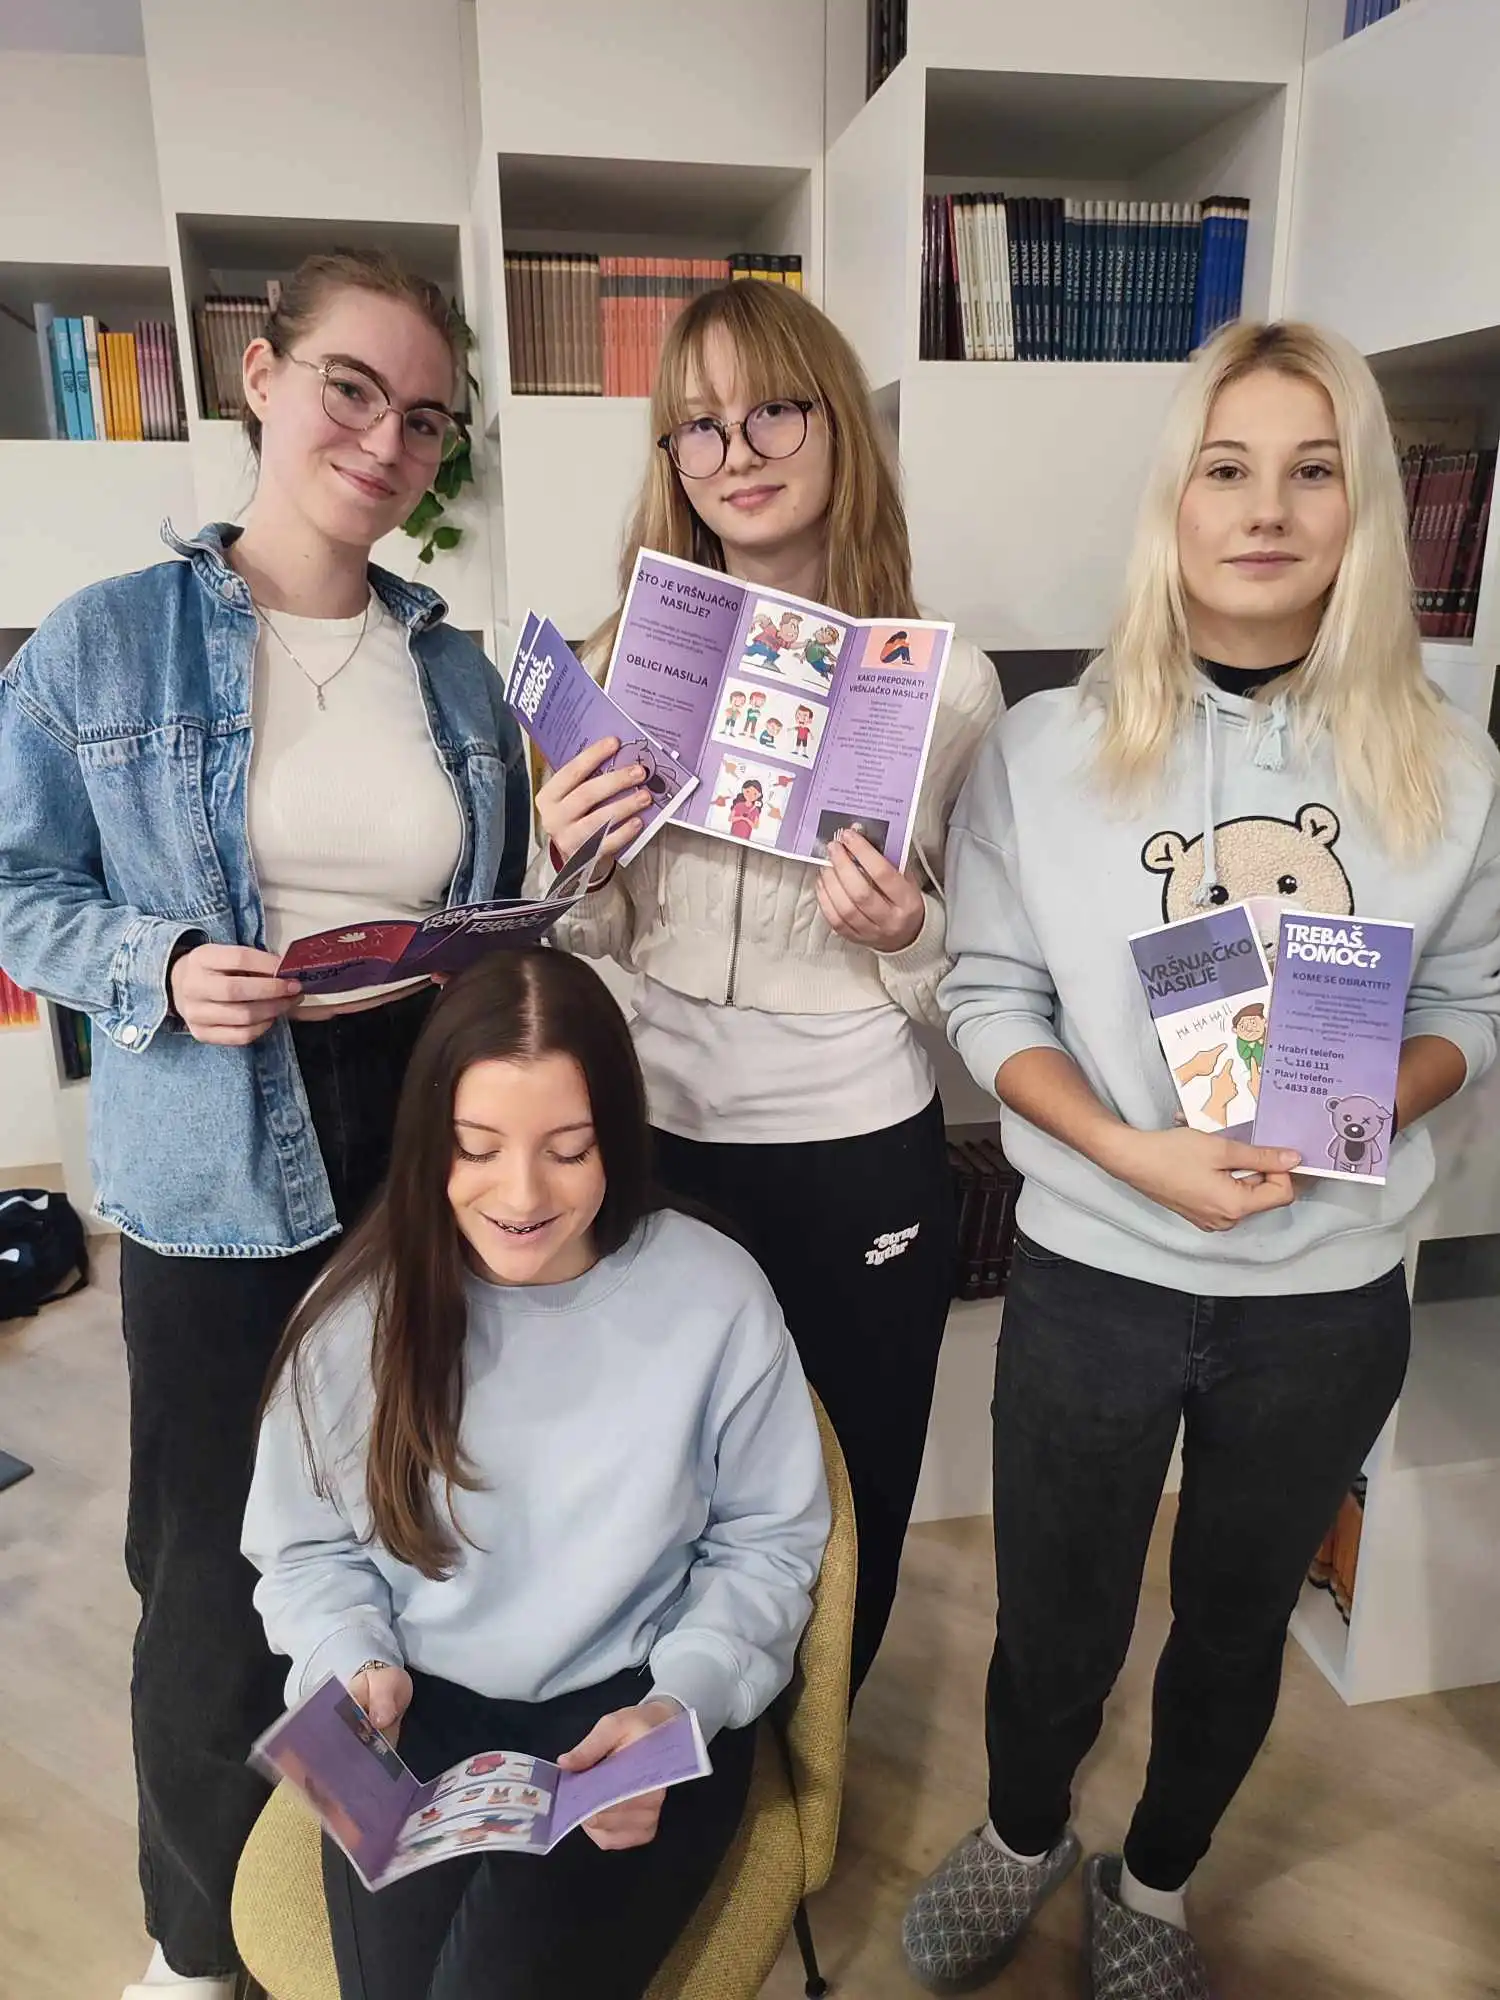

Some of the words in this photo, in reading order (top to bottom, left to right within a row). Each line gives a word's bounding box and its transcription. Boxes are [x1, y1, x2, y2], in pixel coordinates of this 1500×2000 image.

[637, 569, 659, 585] ŠTO
[660, 580, 674, 591] JE
[676, 582, 739, 612] VRŠNJAČKO
[660, 595, 711, 619] NASILJE?
[518, 653, 543, 712] TREBAŠ
[626, 654, 662, 673] OBLICI
[664, 665, 709, 688] NASILJA
[857, 674, 876, 682] KAKO
[877, 675, 926, 688] PREPOZNATI
[849, 683, 891, 696] VRŠNJAČKO
[892, 688, 929, 701] NASILJE?
[1284, 923, 1364, 949] TREBAŠ
[1141, 938, 1253, 983] VRŠNJAČKO
[1286, 942, 1381, 969] POMOĆ?
[1147, 966, 1219, 1000] NASILJE
[1292, 972, 1324, 983] KOME
[1324, 975, 1338, 985] SE
[1338, 977, 1392, 991] OBRATITI?
[1277, 1043, 1308, 1056] Hrabri
[1310, 1047, 1345, 1060] telefon
[1274, 1068, 1298, 1080] Plavi
[1299, 1072, 1335, 1085] telefon
[1295, 1058, 1312, 1068] 116
[1314, 1061, 1330, 1071] 111
[1284, 1083, 1309, 1094] 4833
[1310, 1085, 1329, 1096] 888
